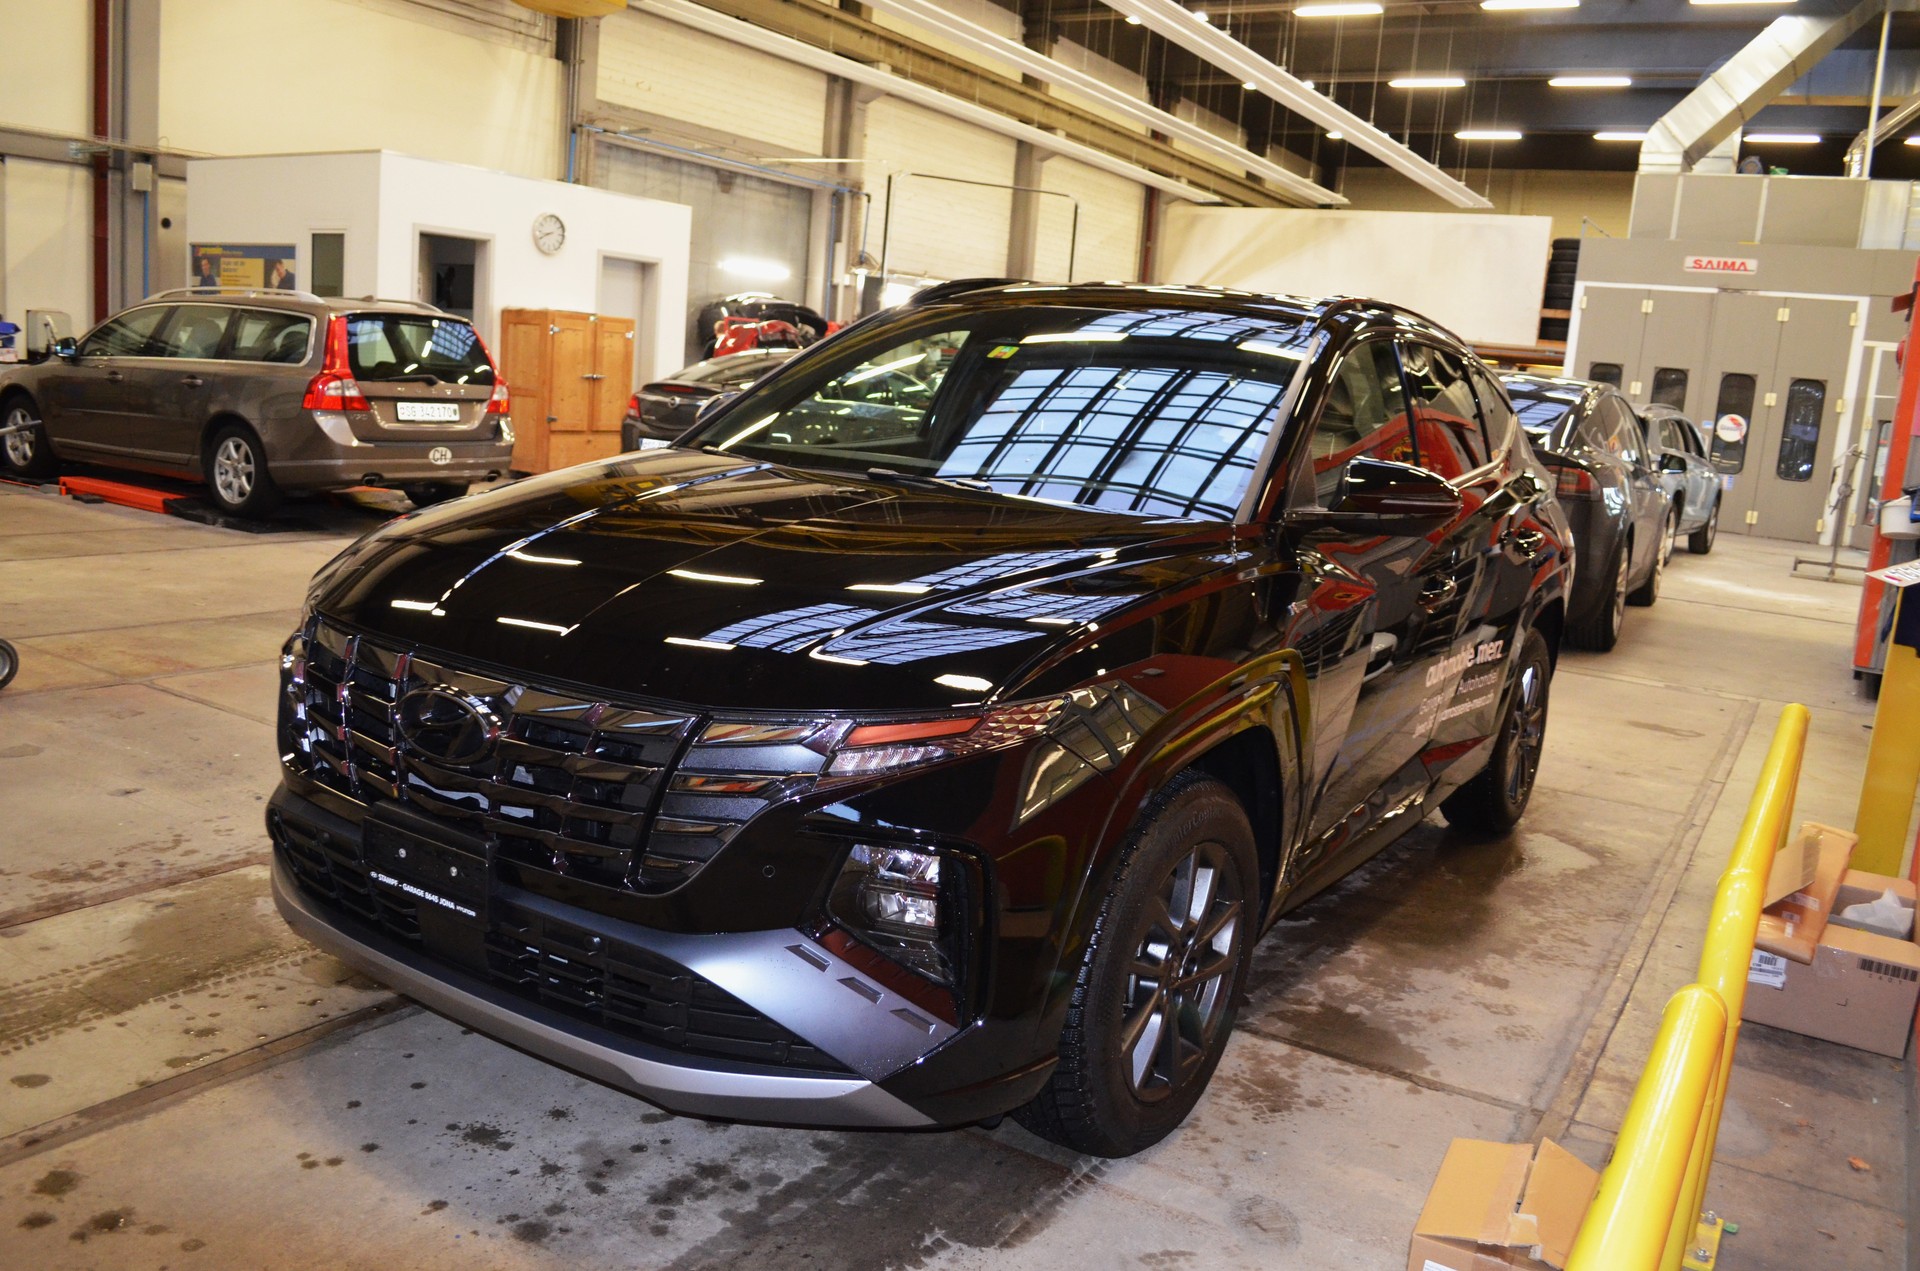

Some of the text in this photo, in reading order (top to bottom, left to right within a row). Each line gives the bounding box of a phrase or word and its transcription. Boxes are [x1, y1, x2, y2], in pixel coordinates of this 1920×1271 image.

[1693, 259, 1749, 272] SAIMA
[432, 449, 448, 462] CH
[378, 873, 399, 887] STAMPF
[402, 883, 424, 898] GARAGE
[439, 898, 455, 909] JONA
